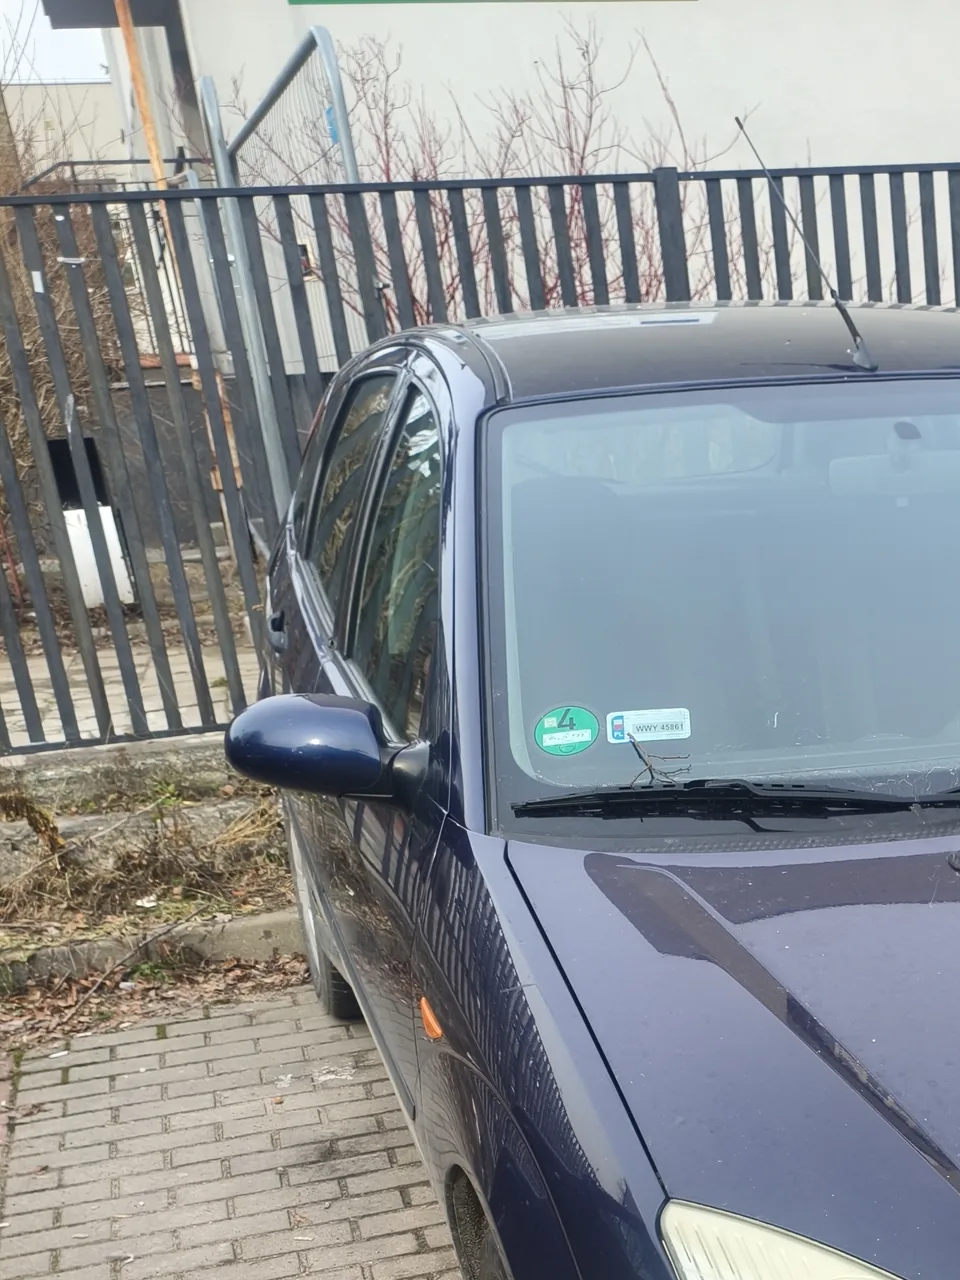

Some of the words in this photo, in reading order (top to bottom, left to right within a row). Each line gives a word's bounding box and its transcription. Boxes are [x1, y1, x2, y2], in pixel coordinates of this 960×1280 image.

[558, 708, 576, 730] 4
[635, 724, 658, 732] WWY
[660, 723, 684, 731] 45861
